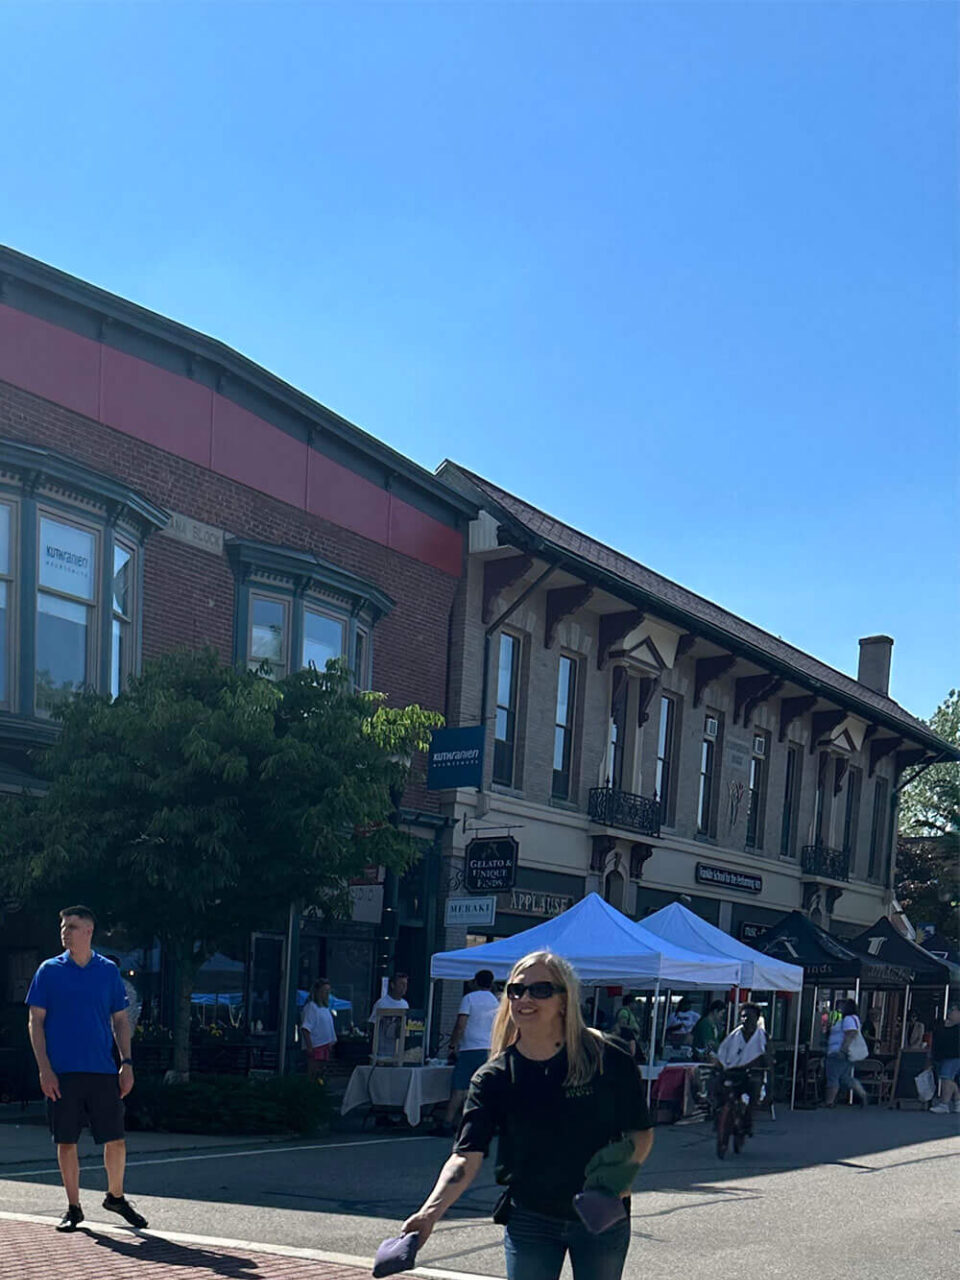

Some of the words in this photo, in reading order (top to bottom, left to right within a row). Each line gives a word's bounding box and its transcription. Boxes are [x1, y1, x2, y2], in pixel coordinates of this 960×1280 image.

[469, 859, 504, 868] GELATO
[472, 869, 507, 879] UNIQUE
[510, 891, 569, 915] APPLAUSE
[449, 903, 490, 914] MERAKI
